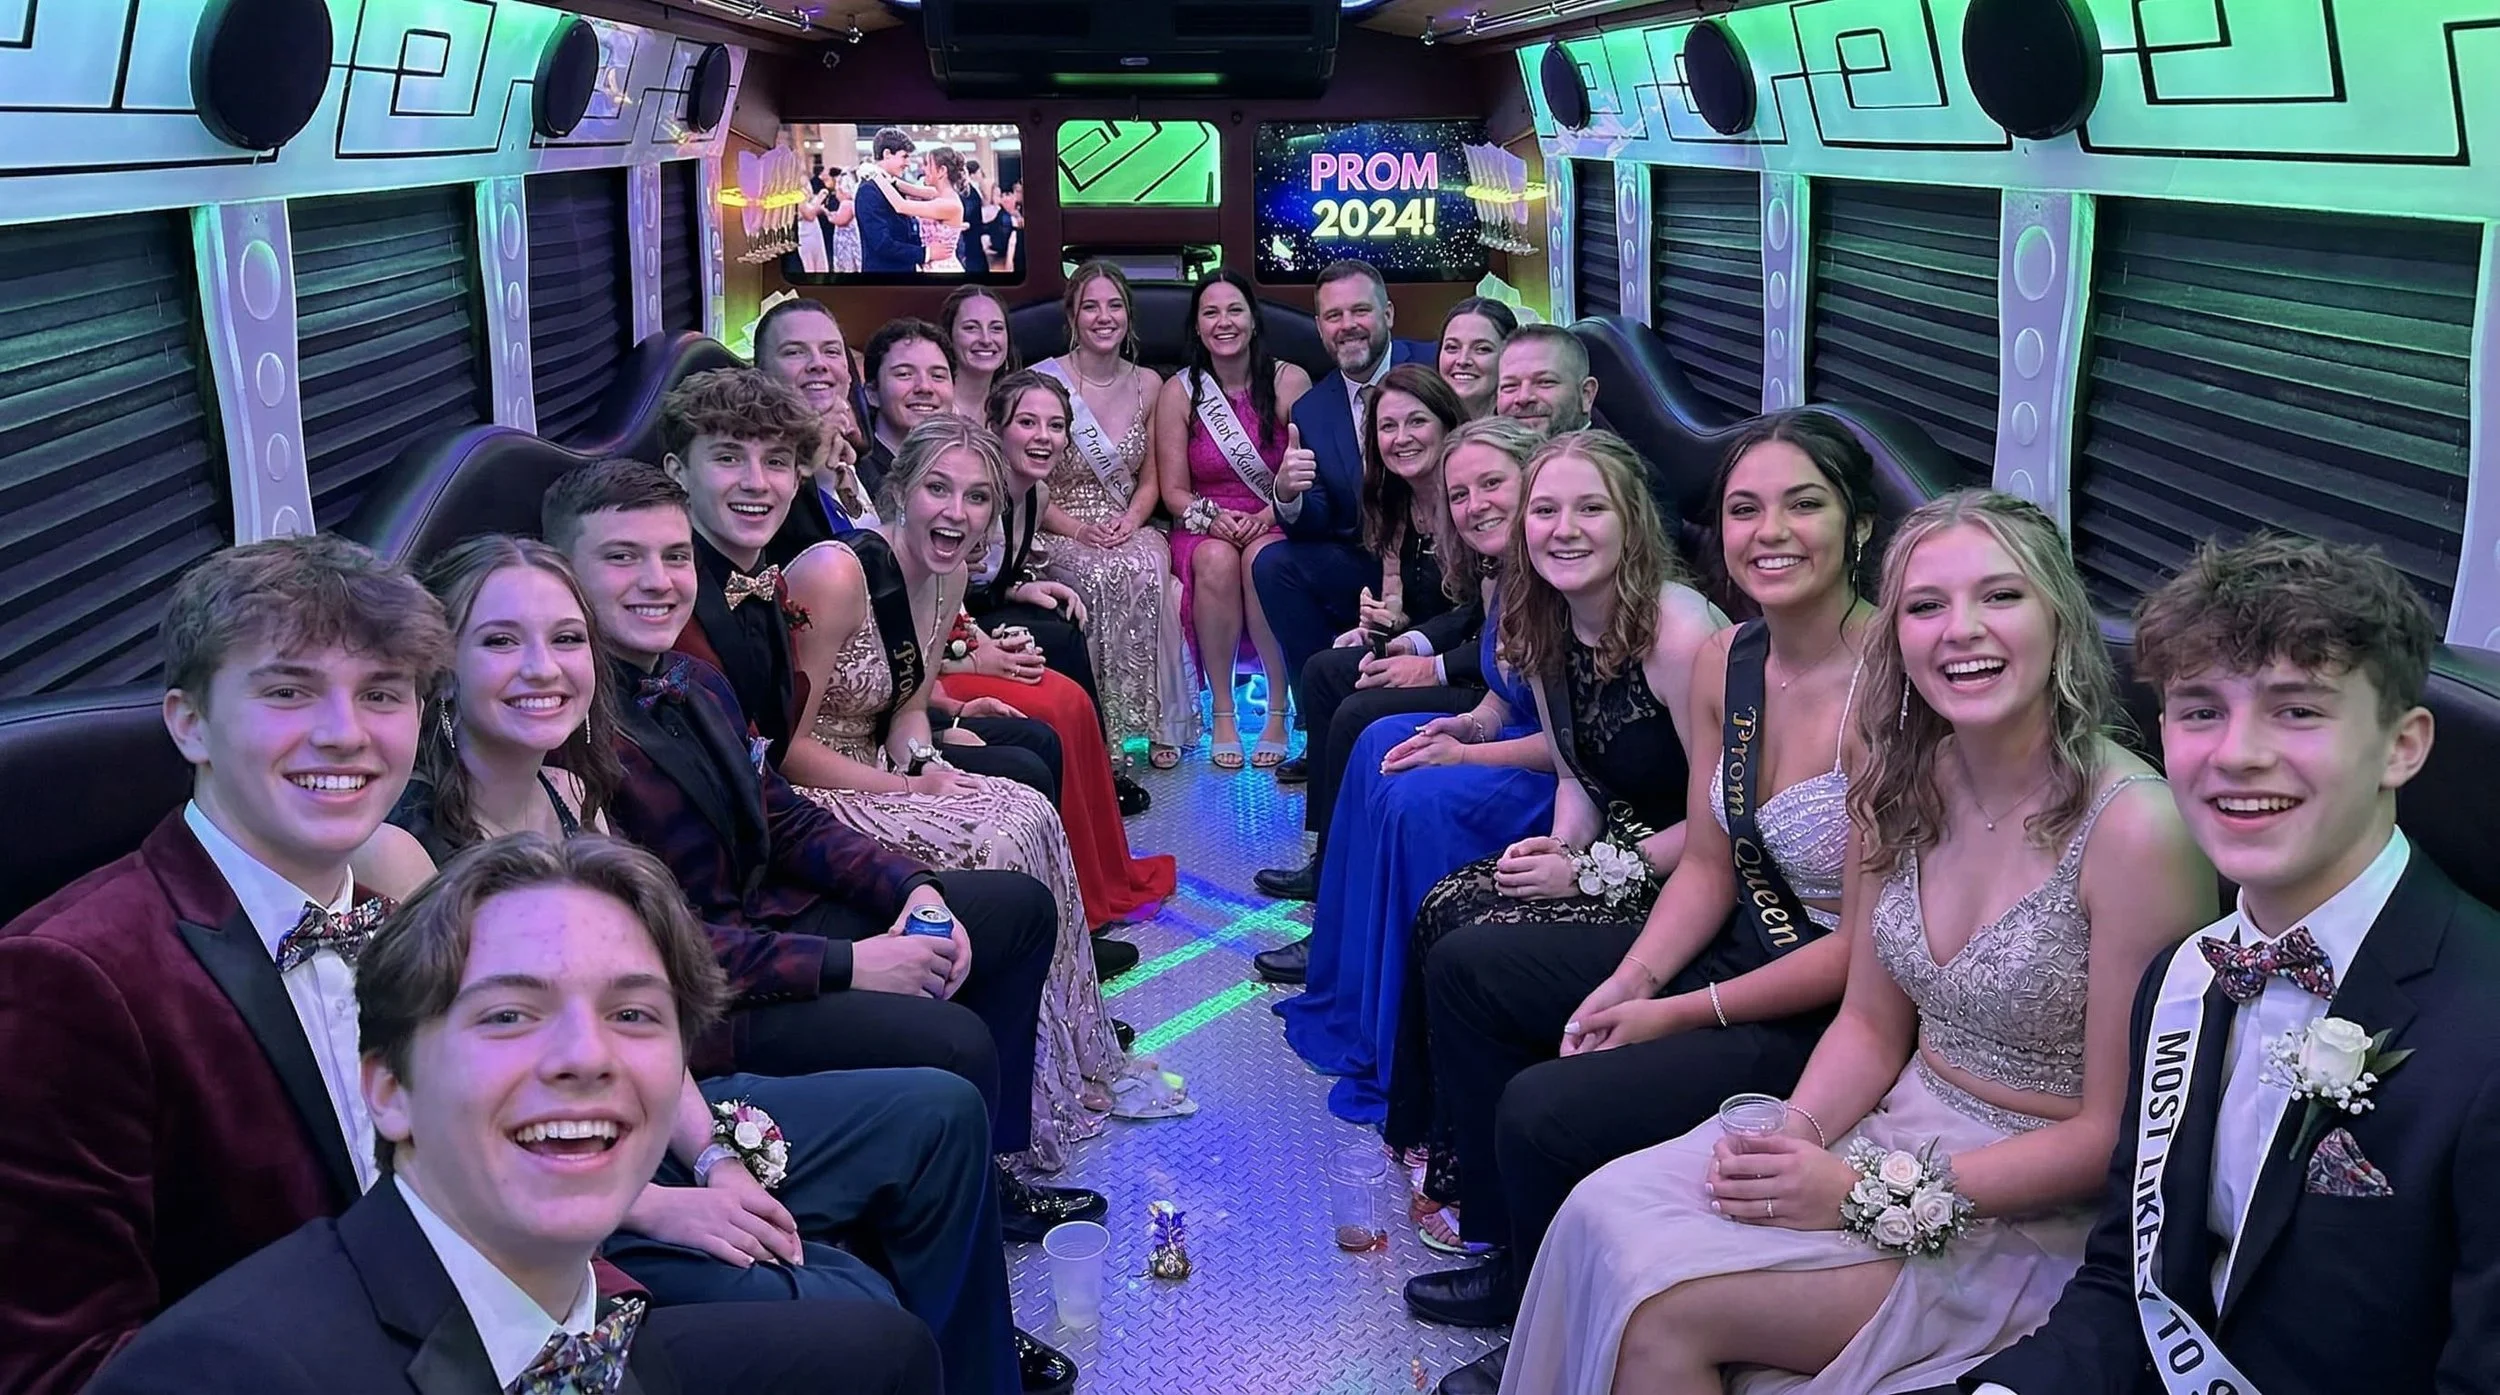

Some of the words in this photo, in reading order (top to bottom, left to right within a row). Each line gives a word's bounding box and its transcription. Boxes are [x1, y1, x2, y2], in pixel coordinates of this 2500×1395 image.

[1311, 152, 1438, 191] PROM
[1311, 197, 1436, 237] 2024!
[1728, 706, 1757, 816] Prom
[1735, 837, 1799, 948] Queen
[2146, 1030, 2191, 1140] MOST
[2137, 1154, 2164, 1301] LIKELY
[2156, 1308, 2205, 1375] TO
